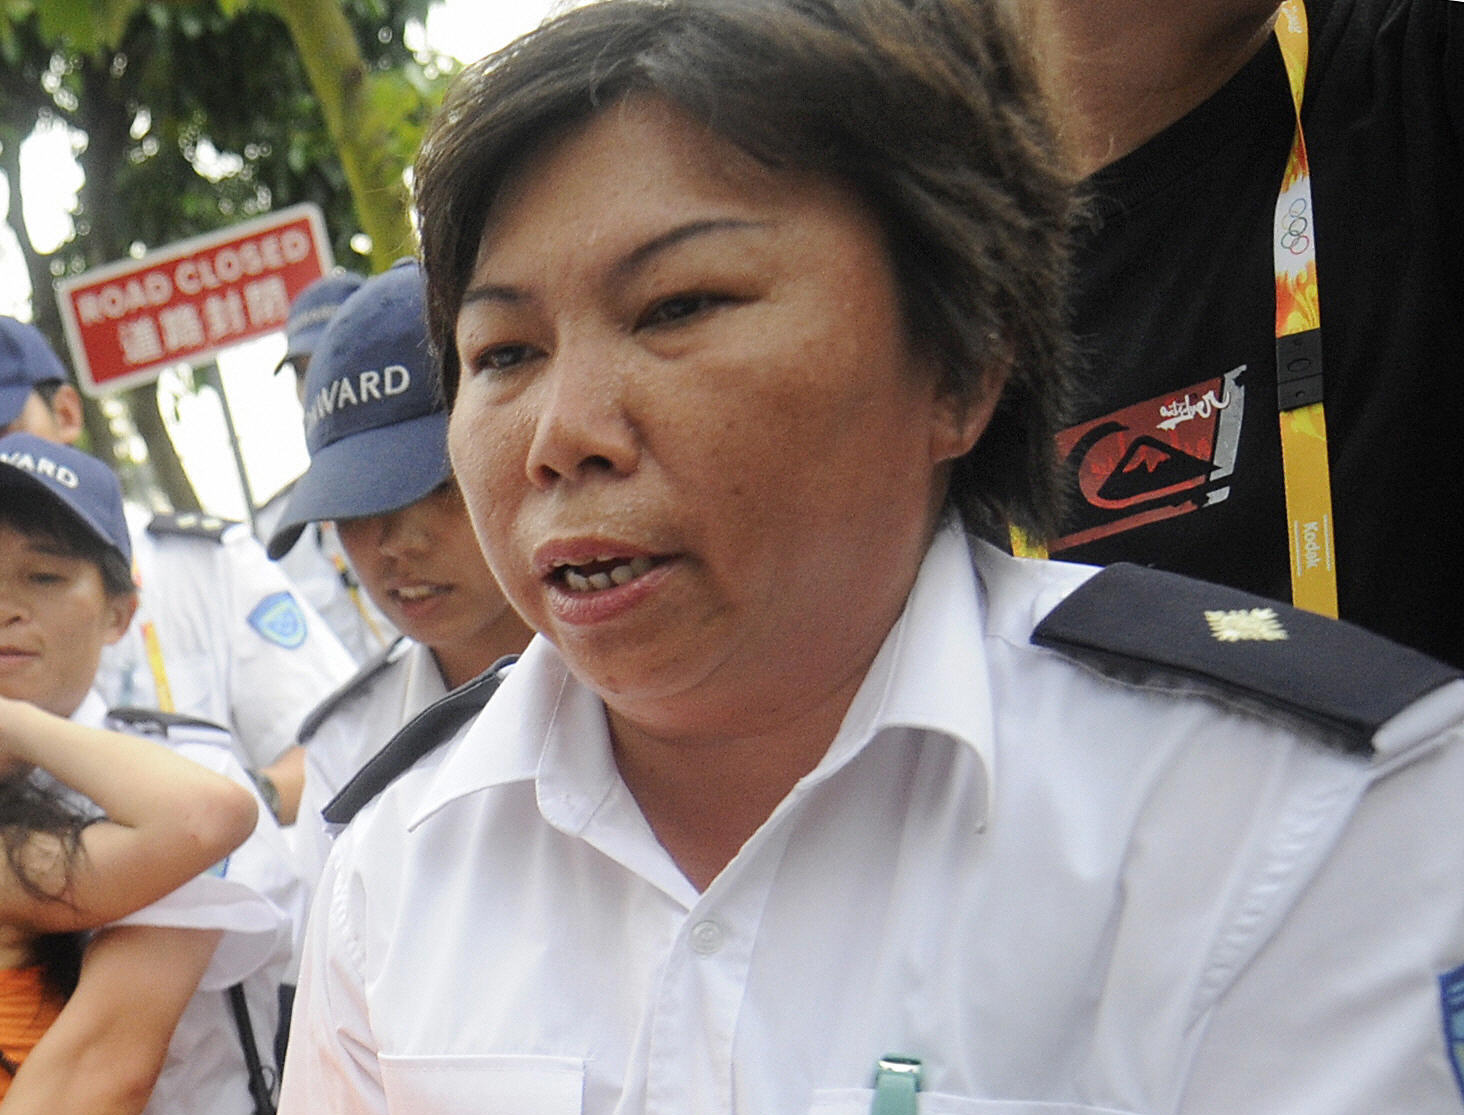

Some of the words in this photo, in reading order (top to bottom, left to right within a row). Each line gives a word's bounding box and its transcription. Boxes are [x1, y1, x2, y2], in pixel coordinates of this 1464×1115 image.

[77, 271, 173, 325] ROAD
[174, 229, 310, 294] CLOSED
[1304, 521, 1322, 569] Kodak
